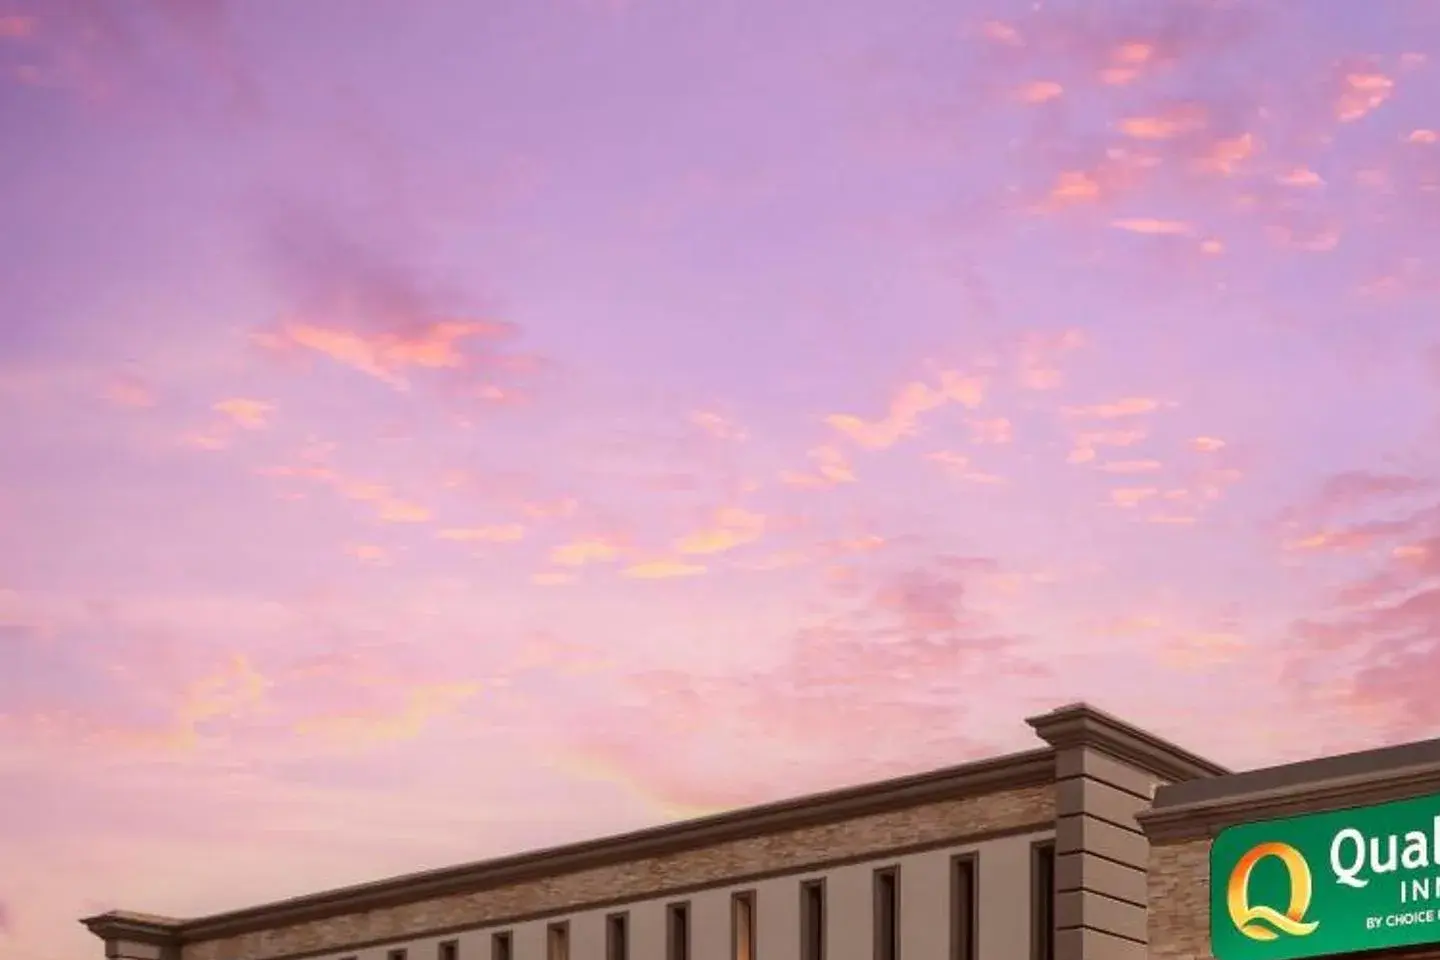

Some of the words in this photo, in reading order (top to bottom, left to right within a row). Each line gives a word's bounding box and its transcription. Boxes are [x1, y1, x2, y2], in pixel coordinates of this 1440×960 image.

[1227, 841, 1320, 941] Q
[1366, 917, 1383, 930] BY
[1386, 909, 1435, 927] CHOICE
